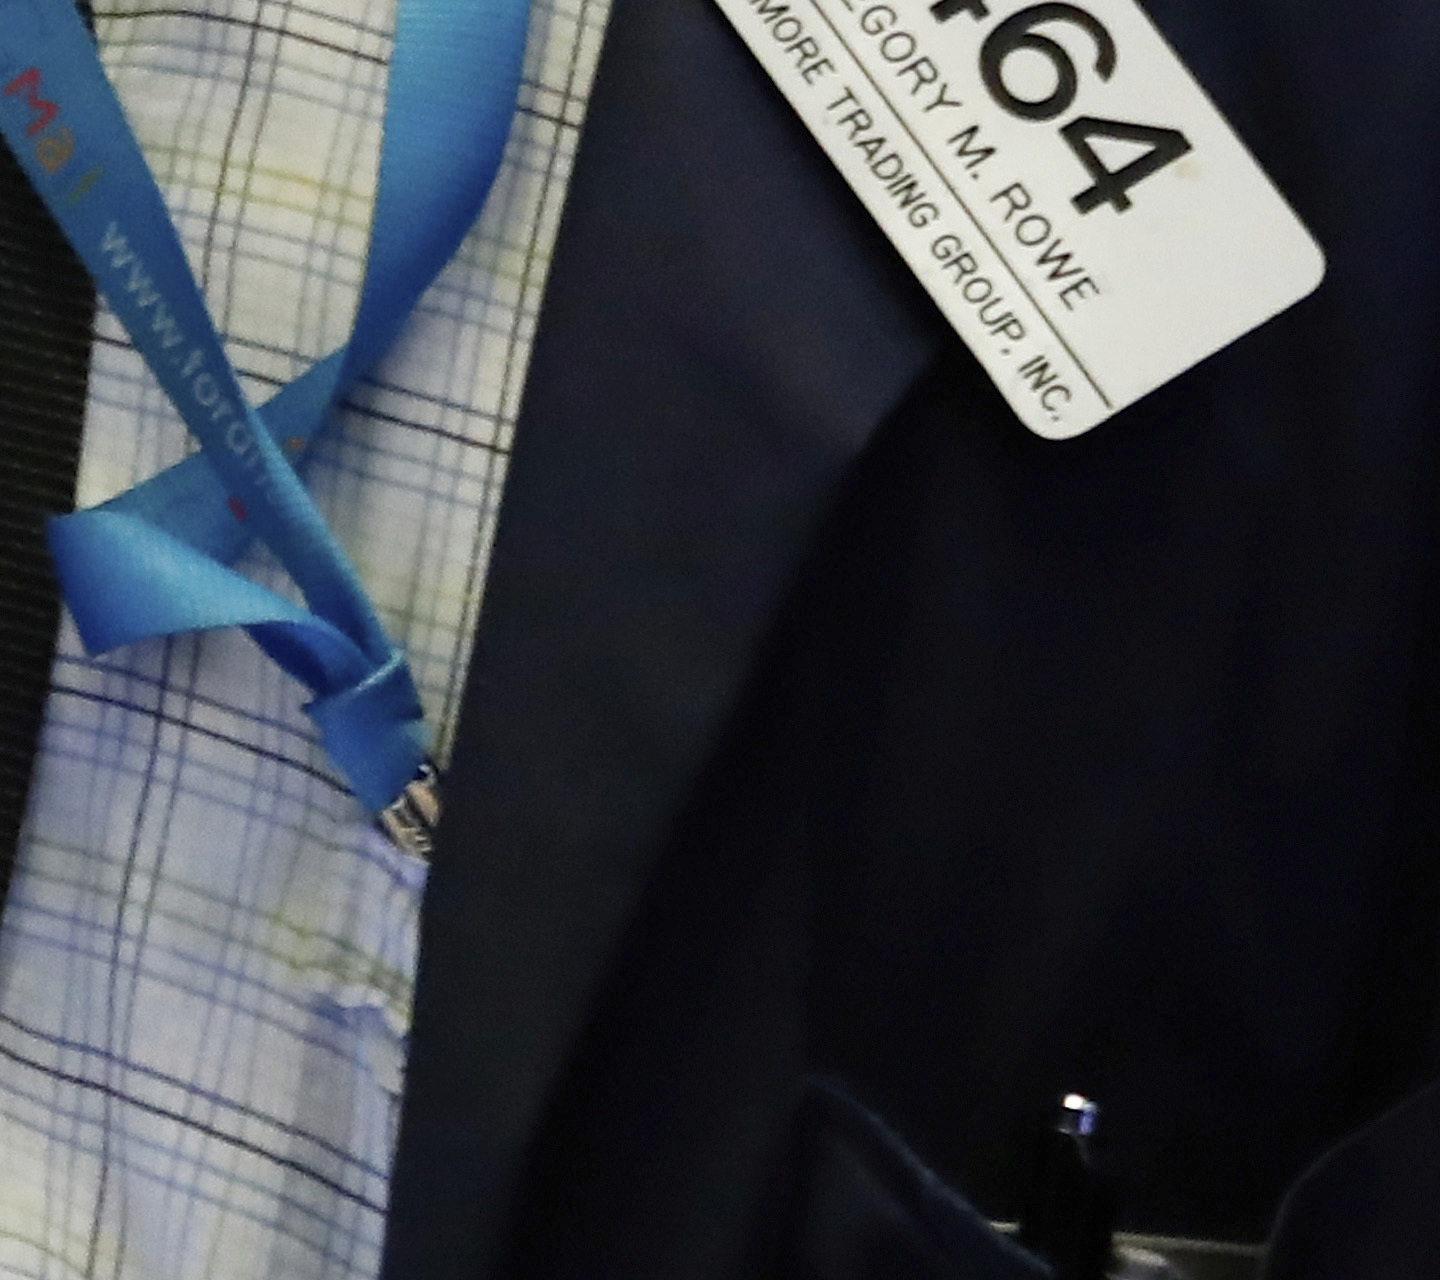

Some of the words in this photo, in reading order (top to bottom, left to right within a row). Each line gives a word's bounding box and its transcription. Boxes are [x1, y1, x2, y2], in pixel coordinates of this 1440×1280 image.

[826, 87, 941, 228] TRADING
[1020, 355, 1075, 423] INC.
[946, 125, 999, 182] M.
[990, 181, 1100, 313] ROWE
